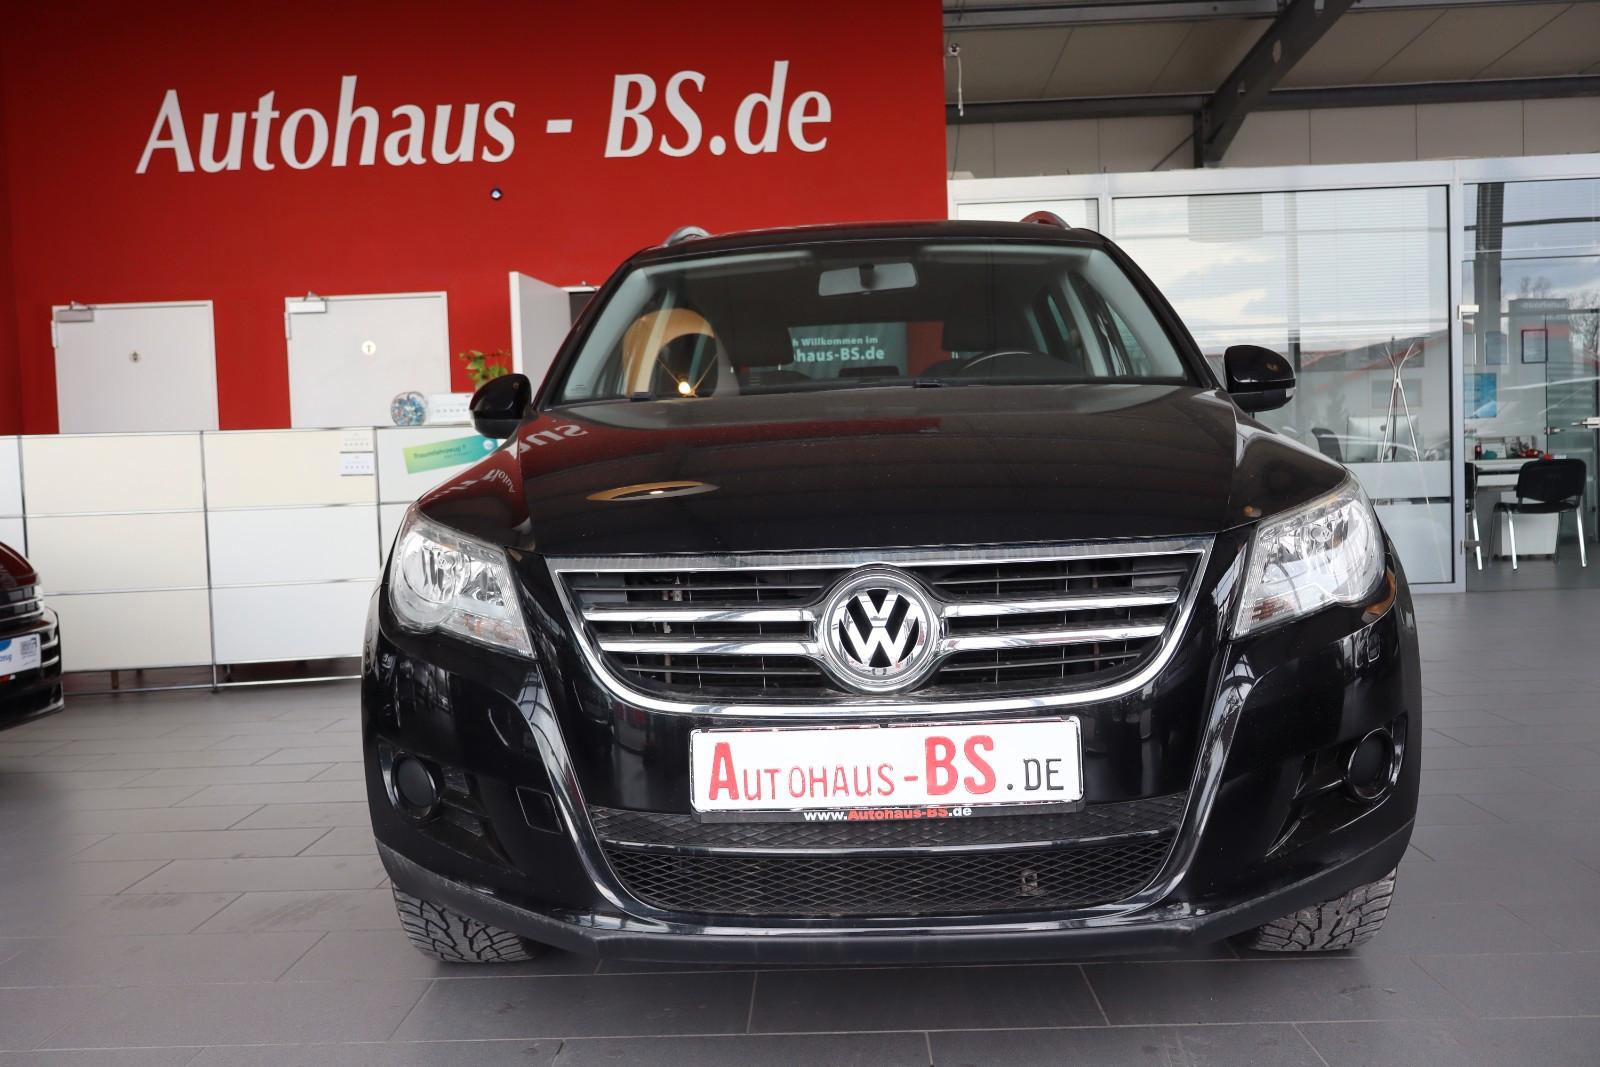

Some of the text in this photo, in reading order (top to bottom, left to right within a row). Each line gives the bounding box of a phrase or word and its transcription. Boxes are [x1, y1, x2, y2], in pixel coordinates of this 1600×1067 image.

[136, 60, 832, 174] Autohaus - BS.de
[801, 336, 863, 347] Willkommen
[865, 335, 878, 344] im
[830, 586, 928, 671] VW
[803, 807, 972, 822] www.Autohaus-BS.de
